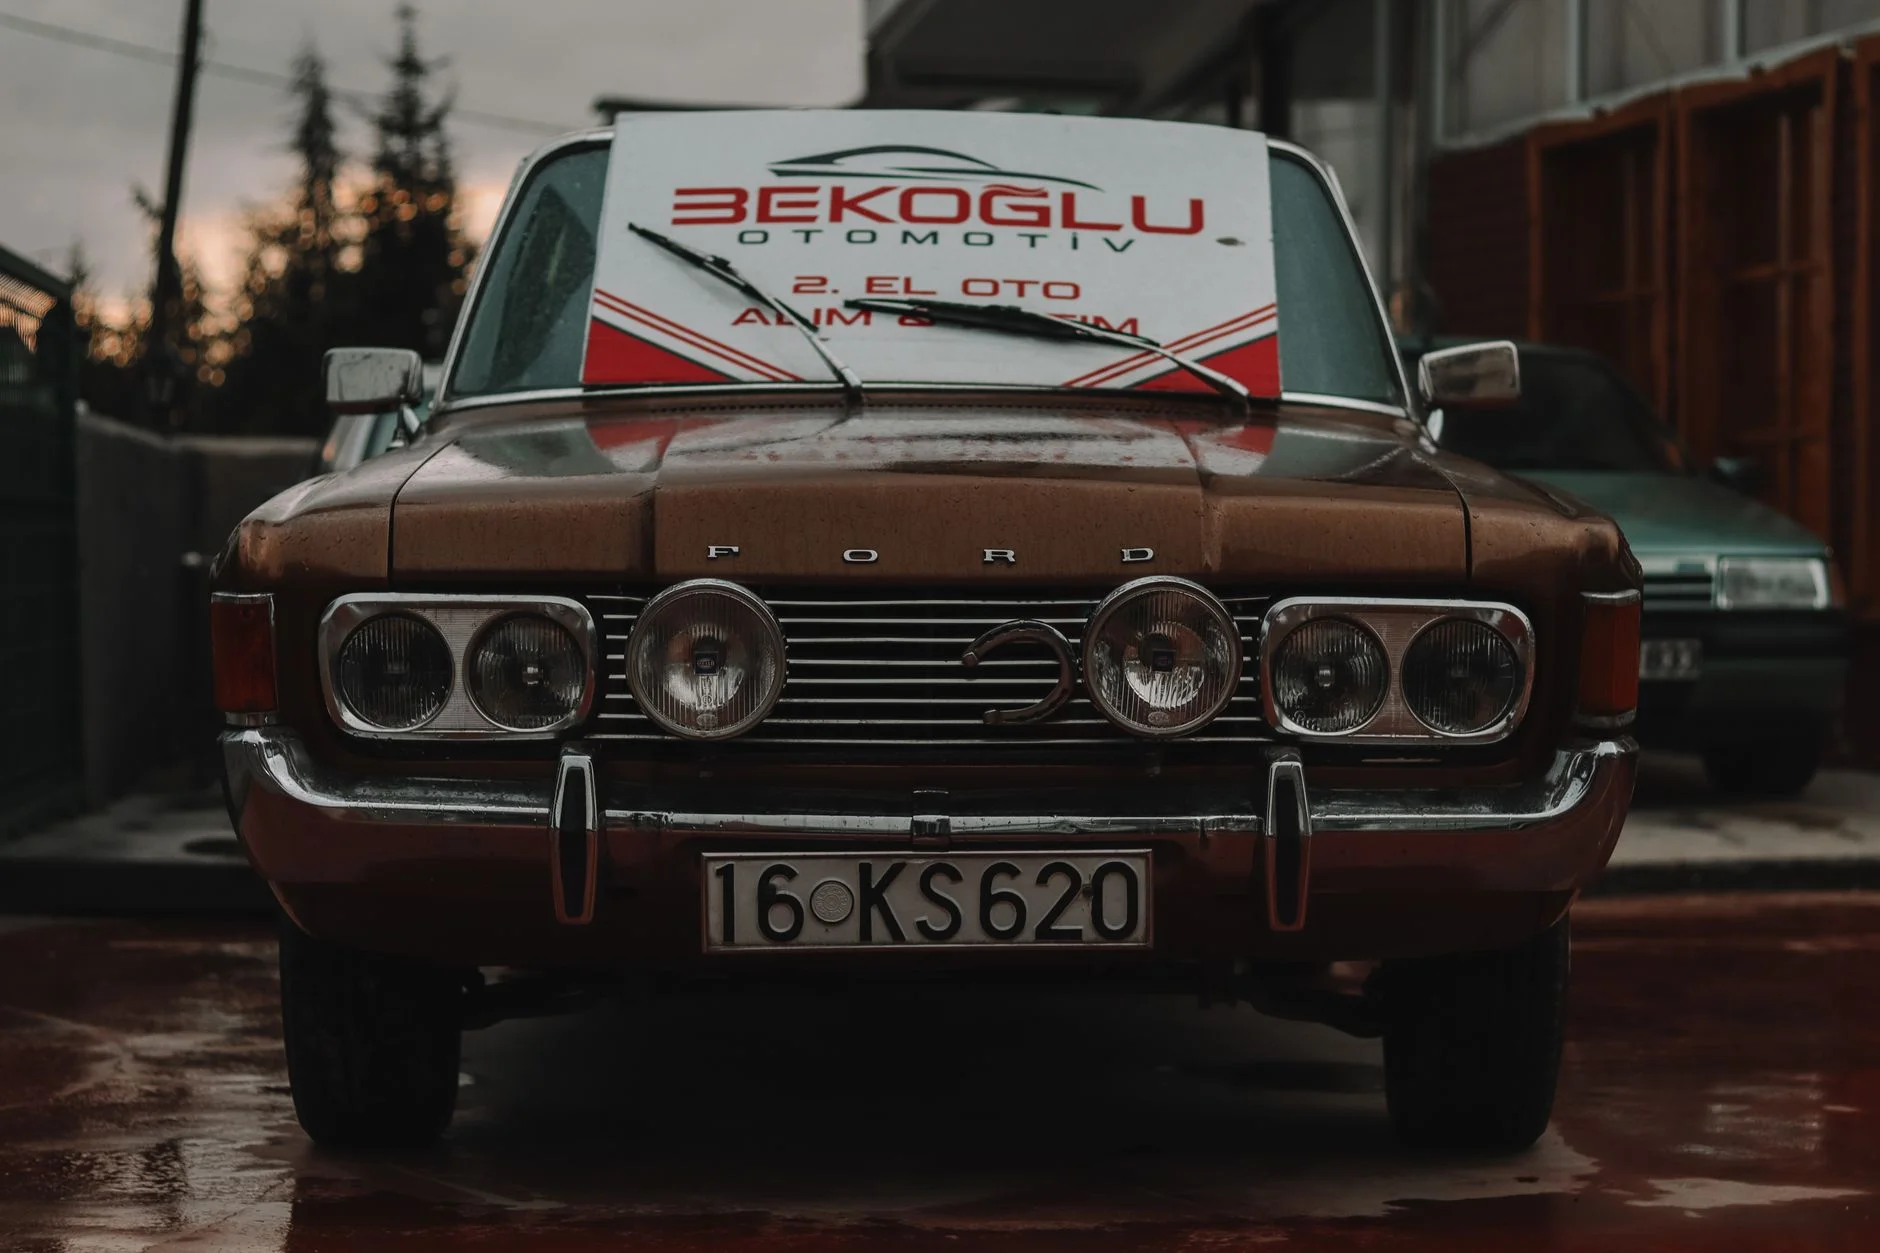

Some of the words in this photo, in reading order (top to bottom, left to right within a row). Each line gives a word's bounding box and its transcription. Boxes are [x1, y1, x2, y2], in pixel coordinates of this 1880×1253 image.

[792, 276, 839, 294] 2.
[865, 276, 937, 295] EL
[961, 278, 1081, 300] OTO
[707, 545, 1154, 563] FORD
[715, 862, 805, 944] 16
